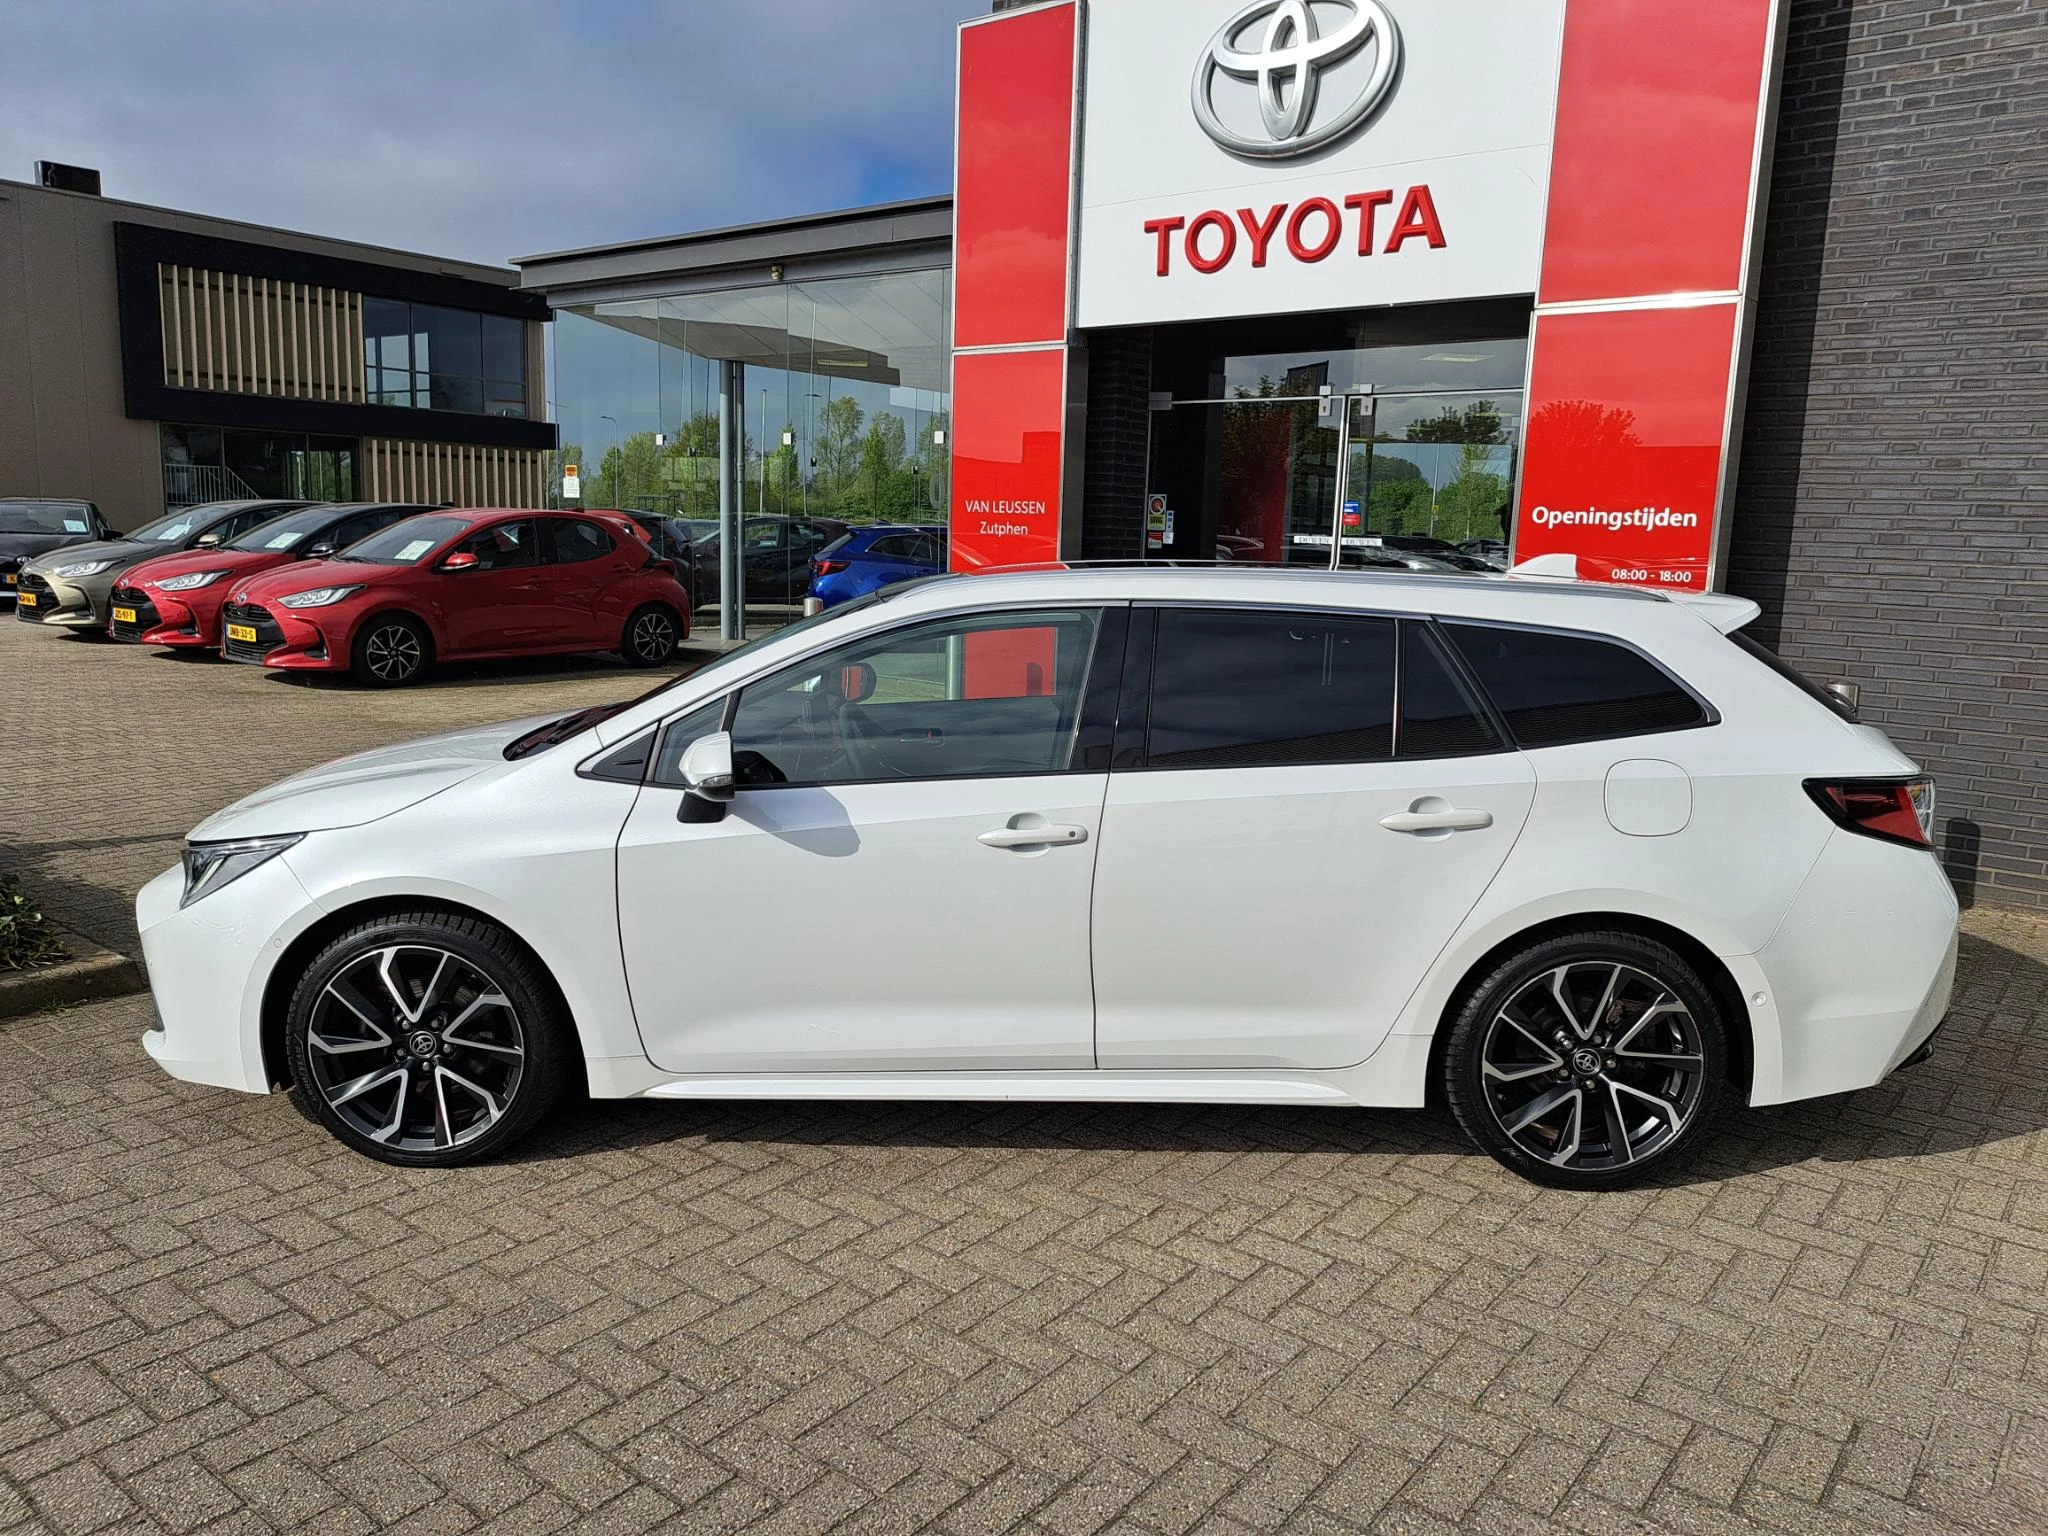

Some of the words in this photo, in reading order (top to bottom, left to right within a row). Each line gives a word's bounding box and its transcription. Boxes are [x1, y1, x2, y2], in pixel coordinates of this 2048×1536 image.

[1144, 184, 1447, 276] TOYOTA
[965, 500, 990, 513] VAN
[993, 500, 1046, 514] LEUSSEN
[1532, 506, 1698, 532] Openingstijden
[980, 521, 1029, 537] Zutphen
[1611, 568, 1648, 581] 08:00
[1659, 570, 1692, 582] 18:00
